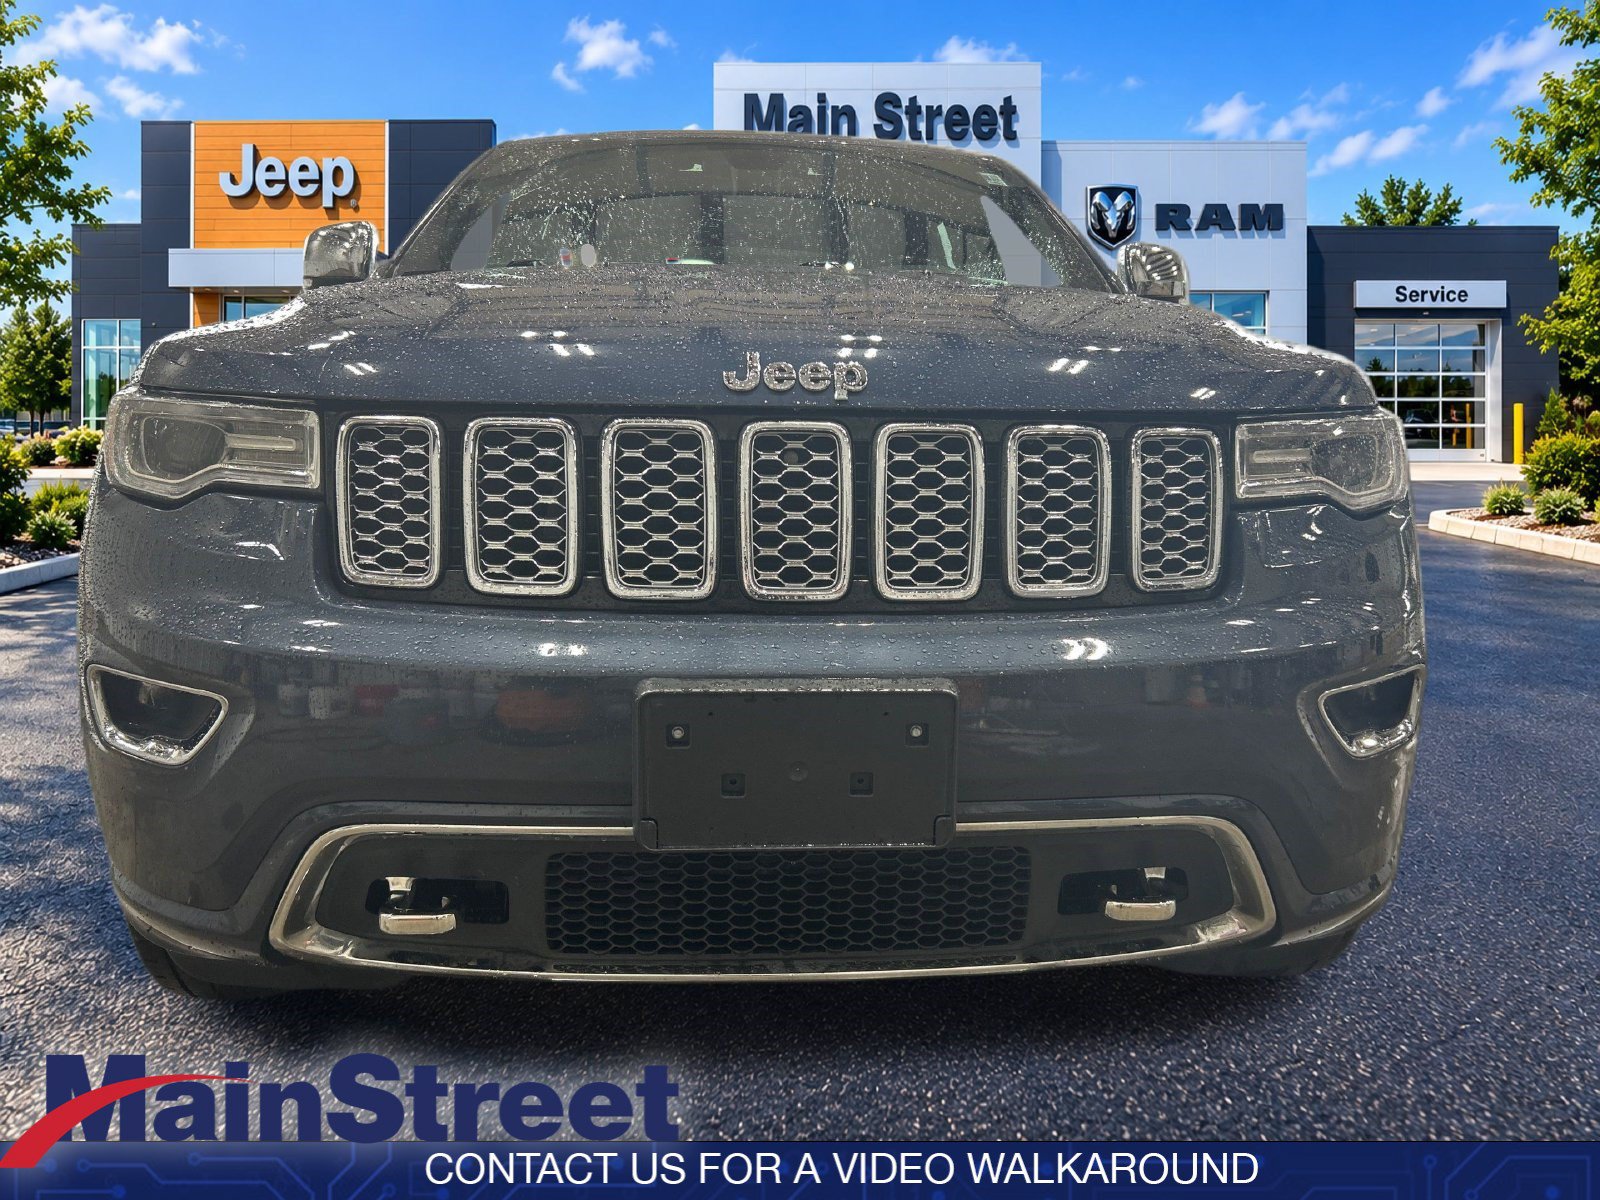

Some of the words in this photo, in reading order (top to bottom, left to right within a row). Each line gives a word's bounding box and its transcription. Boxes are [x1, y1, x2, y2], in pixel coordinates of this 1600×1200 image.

[743, 92, 857, 137] Main
[873, 91, 1018, 141] Street
[218, 143, 356, 208] Jeep
[1155, 203, 1284, 232] RAM
[1395, 285, 1469, 304] Service
[722, 350, 869, 400] Jeep
